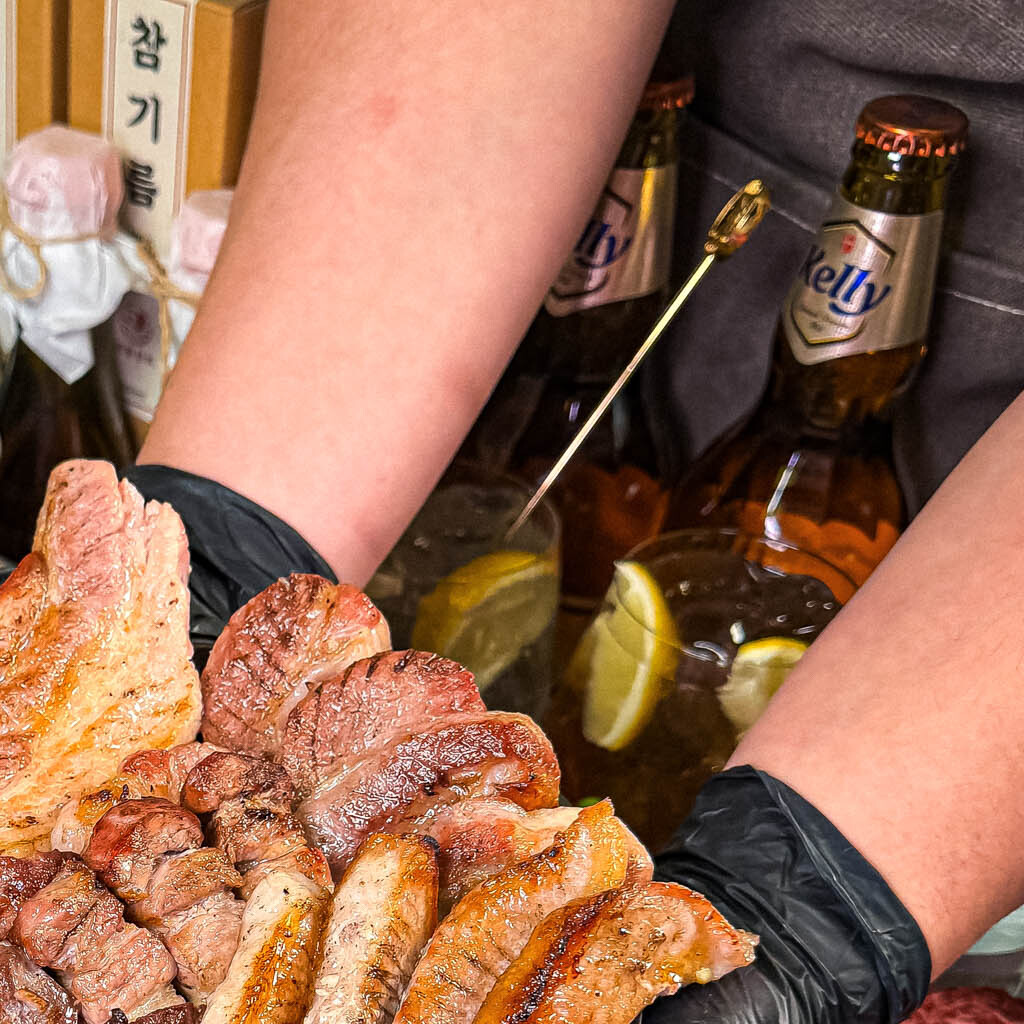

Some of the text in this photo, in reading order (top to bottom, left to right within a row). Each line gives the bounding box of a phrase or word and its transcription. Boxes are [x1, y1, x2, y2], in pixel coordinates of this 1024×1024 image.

[126, 16, 167, 208] 참기름
[574, 219, 632, 268] lly
[799, 244, 891, 316] Kelly
